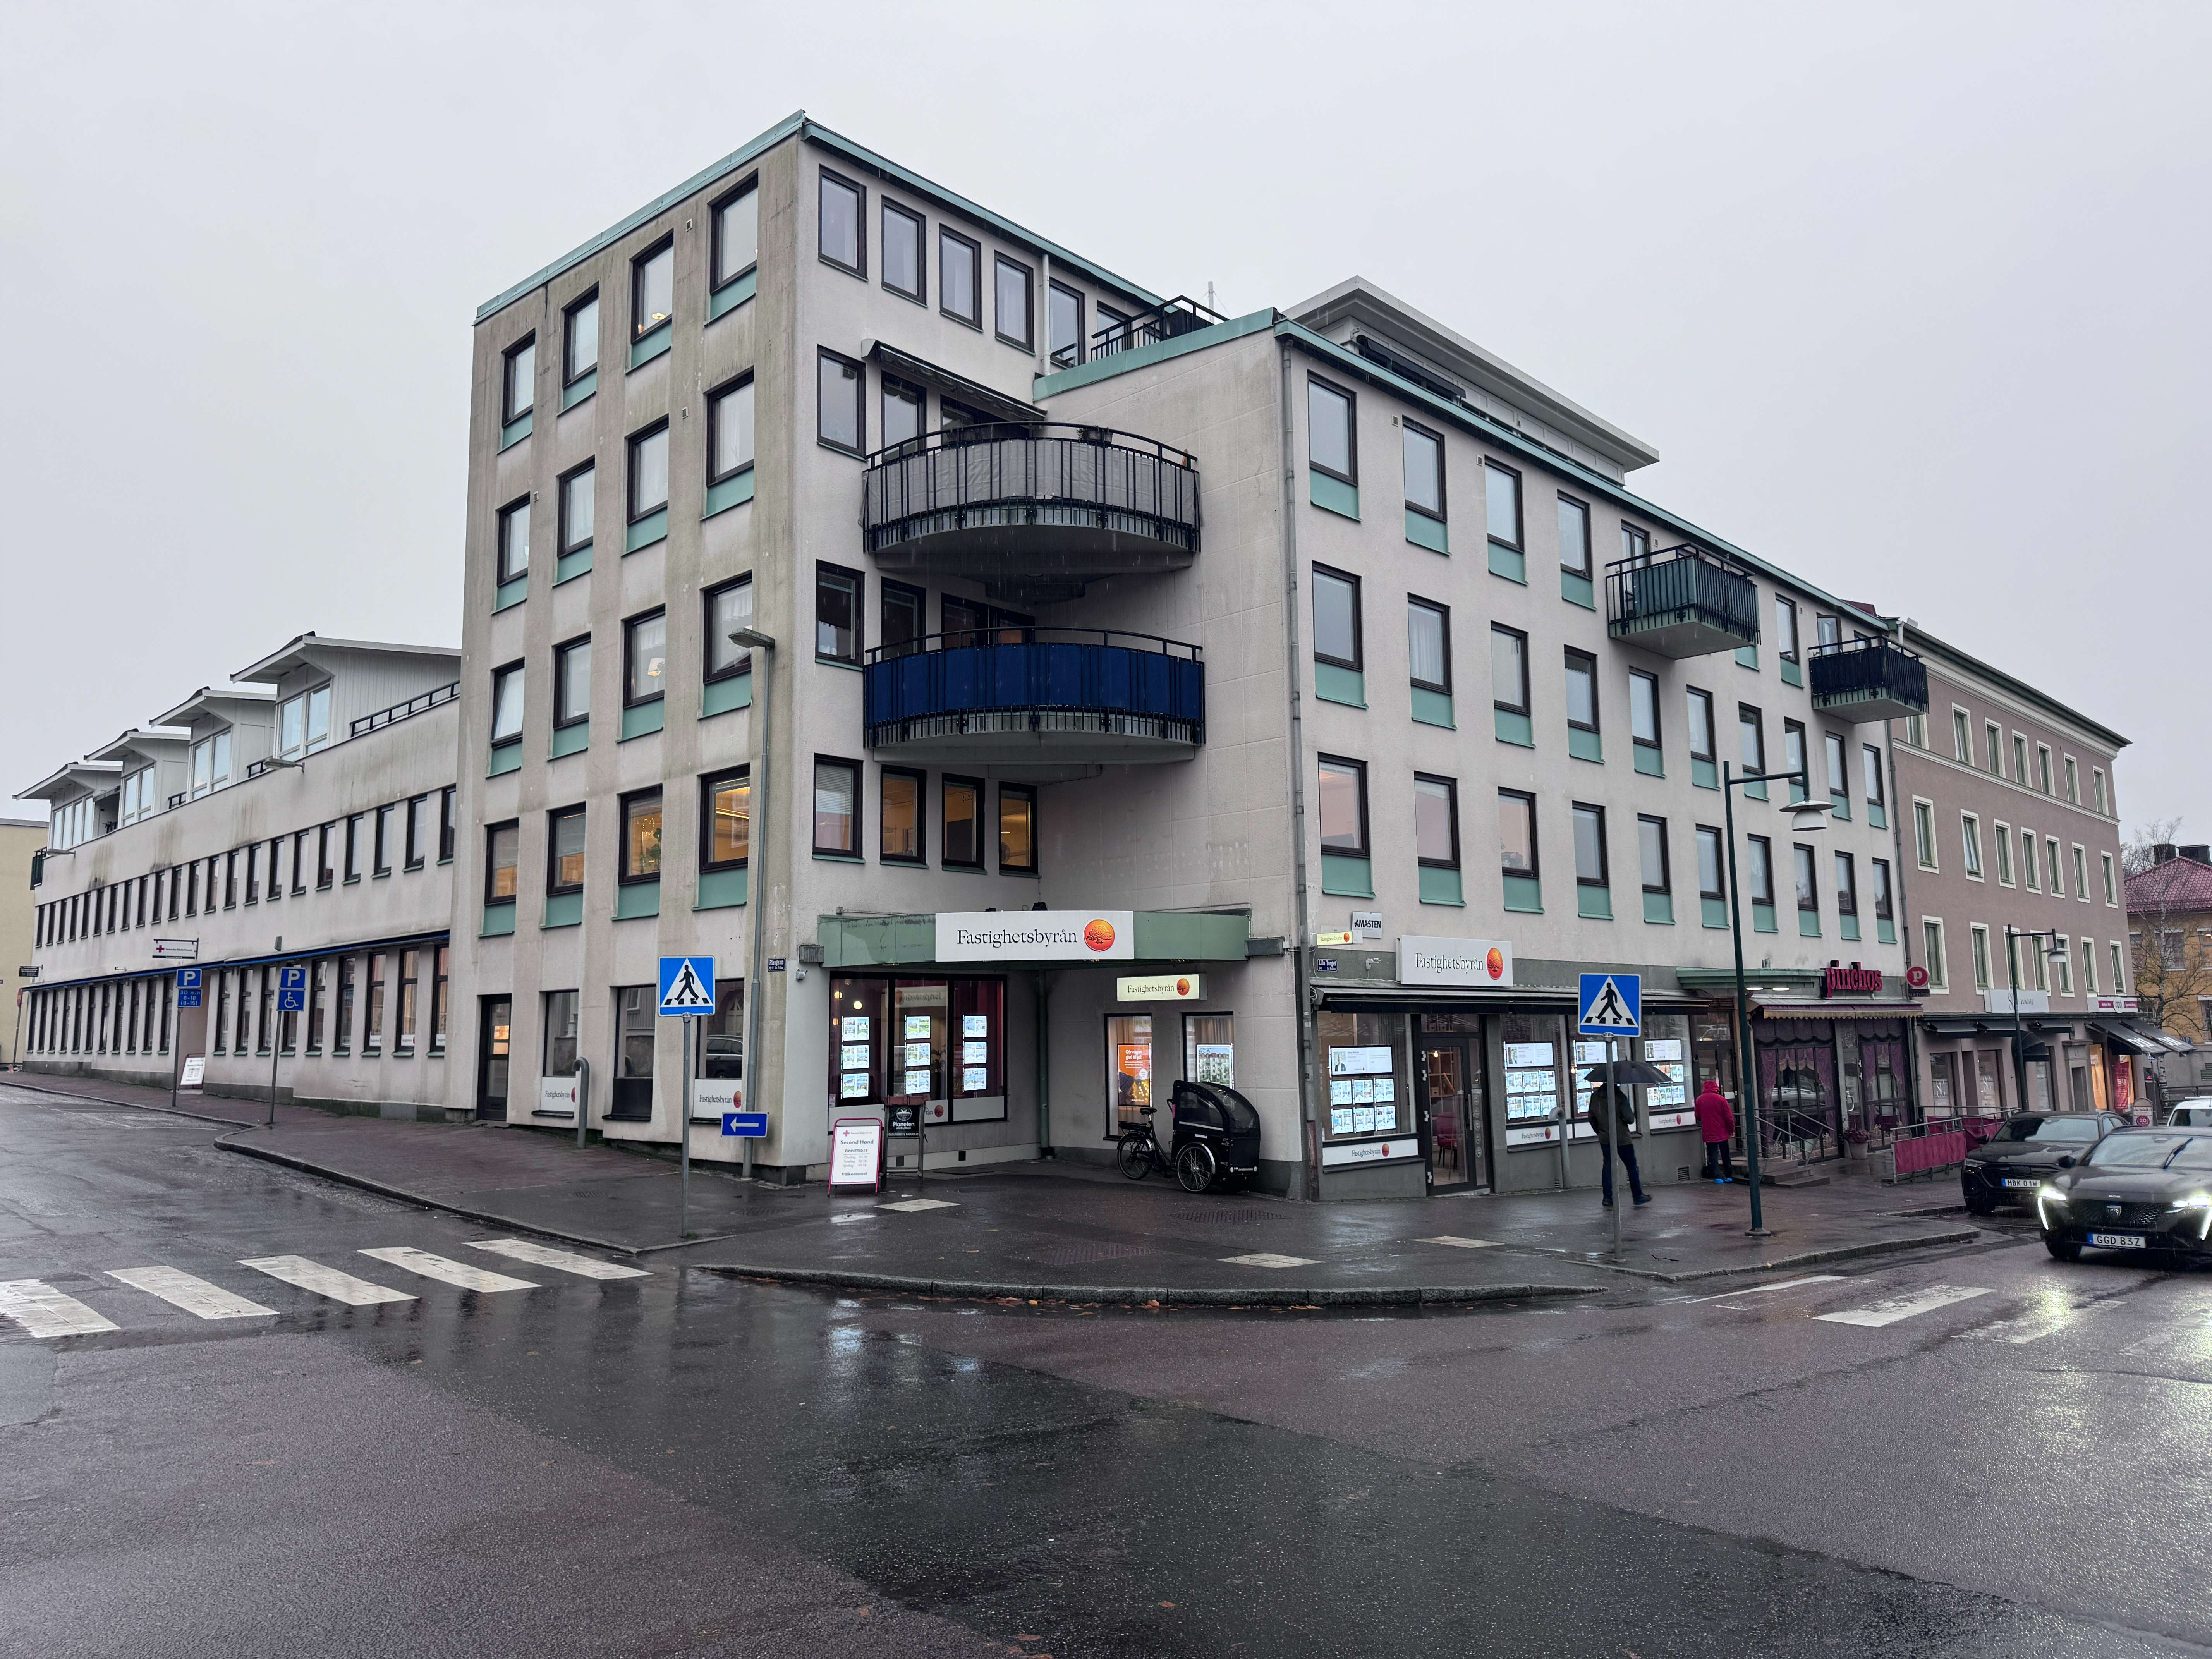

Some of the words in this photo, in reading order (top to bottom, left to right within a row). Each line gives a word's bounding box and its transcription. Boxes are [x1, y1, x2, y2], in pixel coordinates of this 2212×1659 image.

[1355, 920, 1381, 928] AMASTEN
[957, 929, 1077, 948] Fastighetsbyrån
[1415, 953, 1483, 974] Fastighetsbyrån
[184, 971, 196, 986] P
[288, 970, 300, 986] P
[1826, 960, 1882, 998] pinchos
[1128, 984, 1174, 994] Fastighetsbyrån
[699, 1094, 732, 1105] Fastighetsbyrån
[2097, 1235, 2116, 1245] GGD
